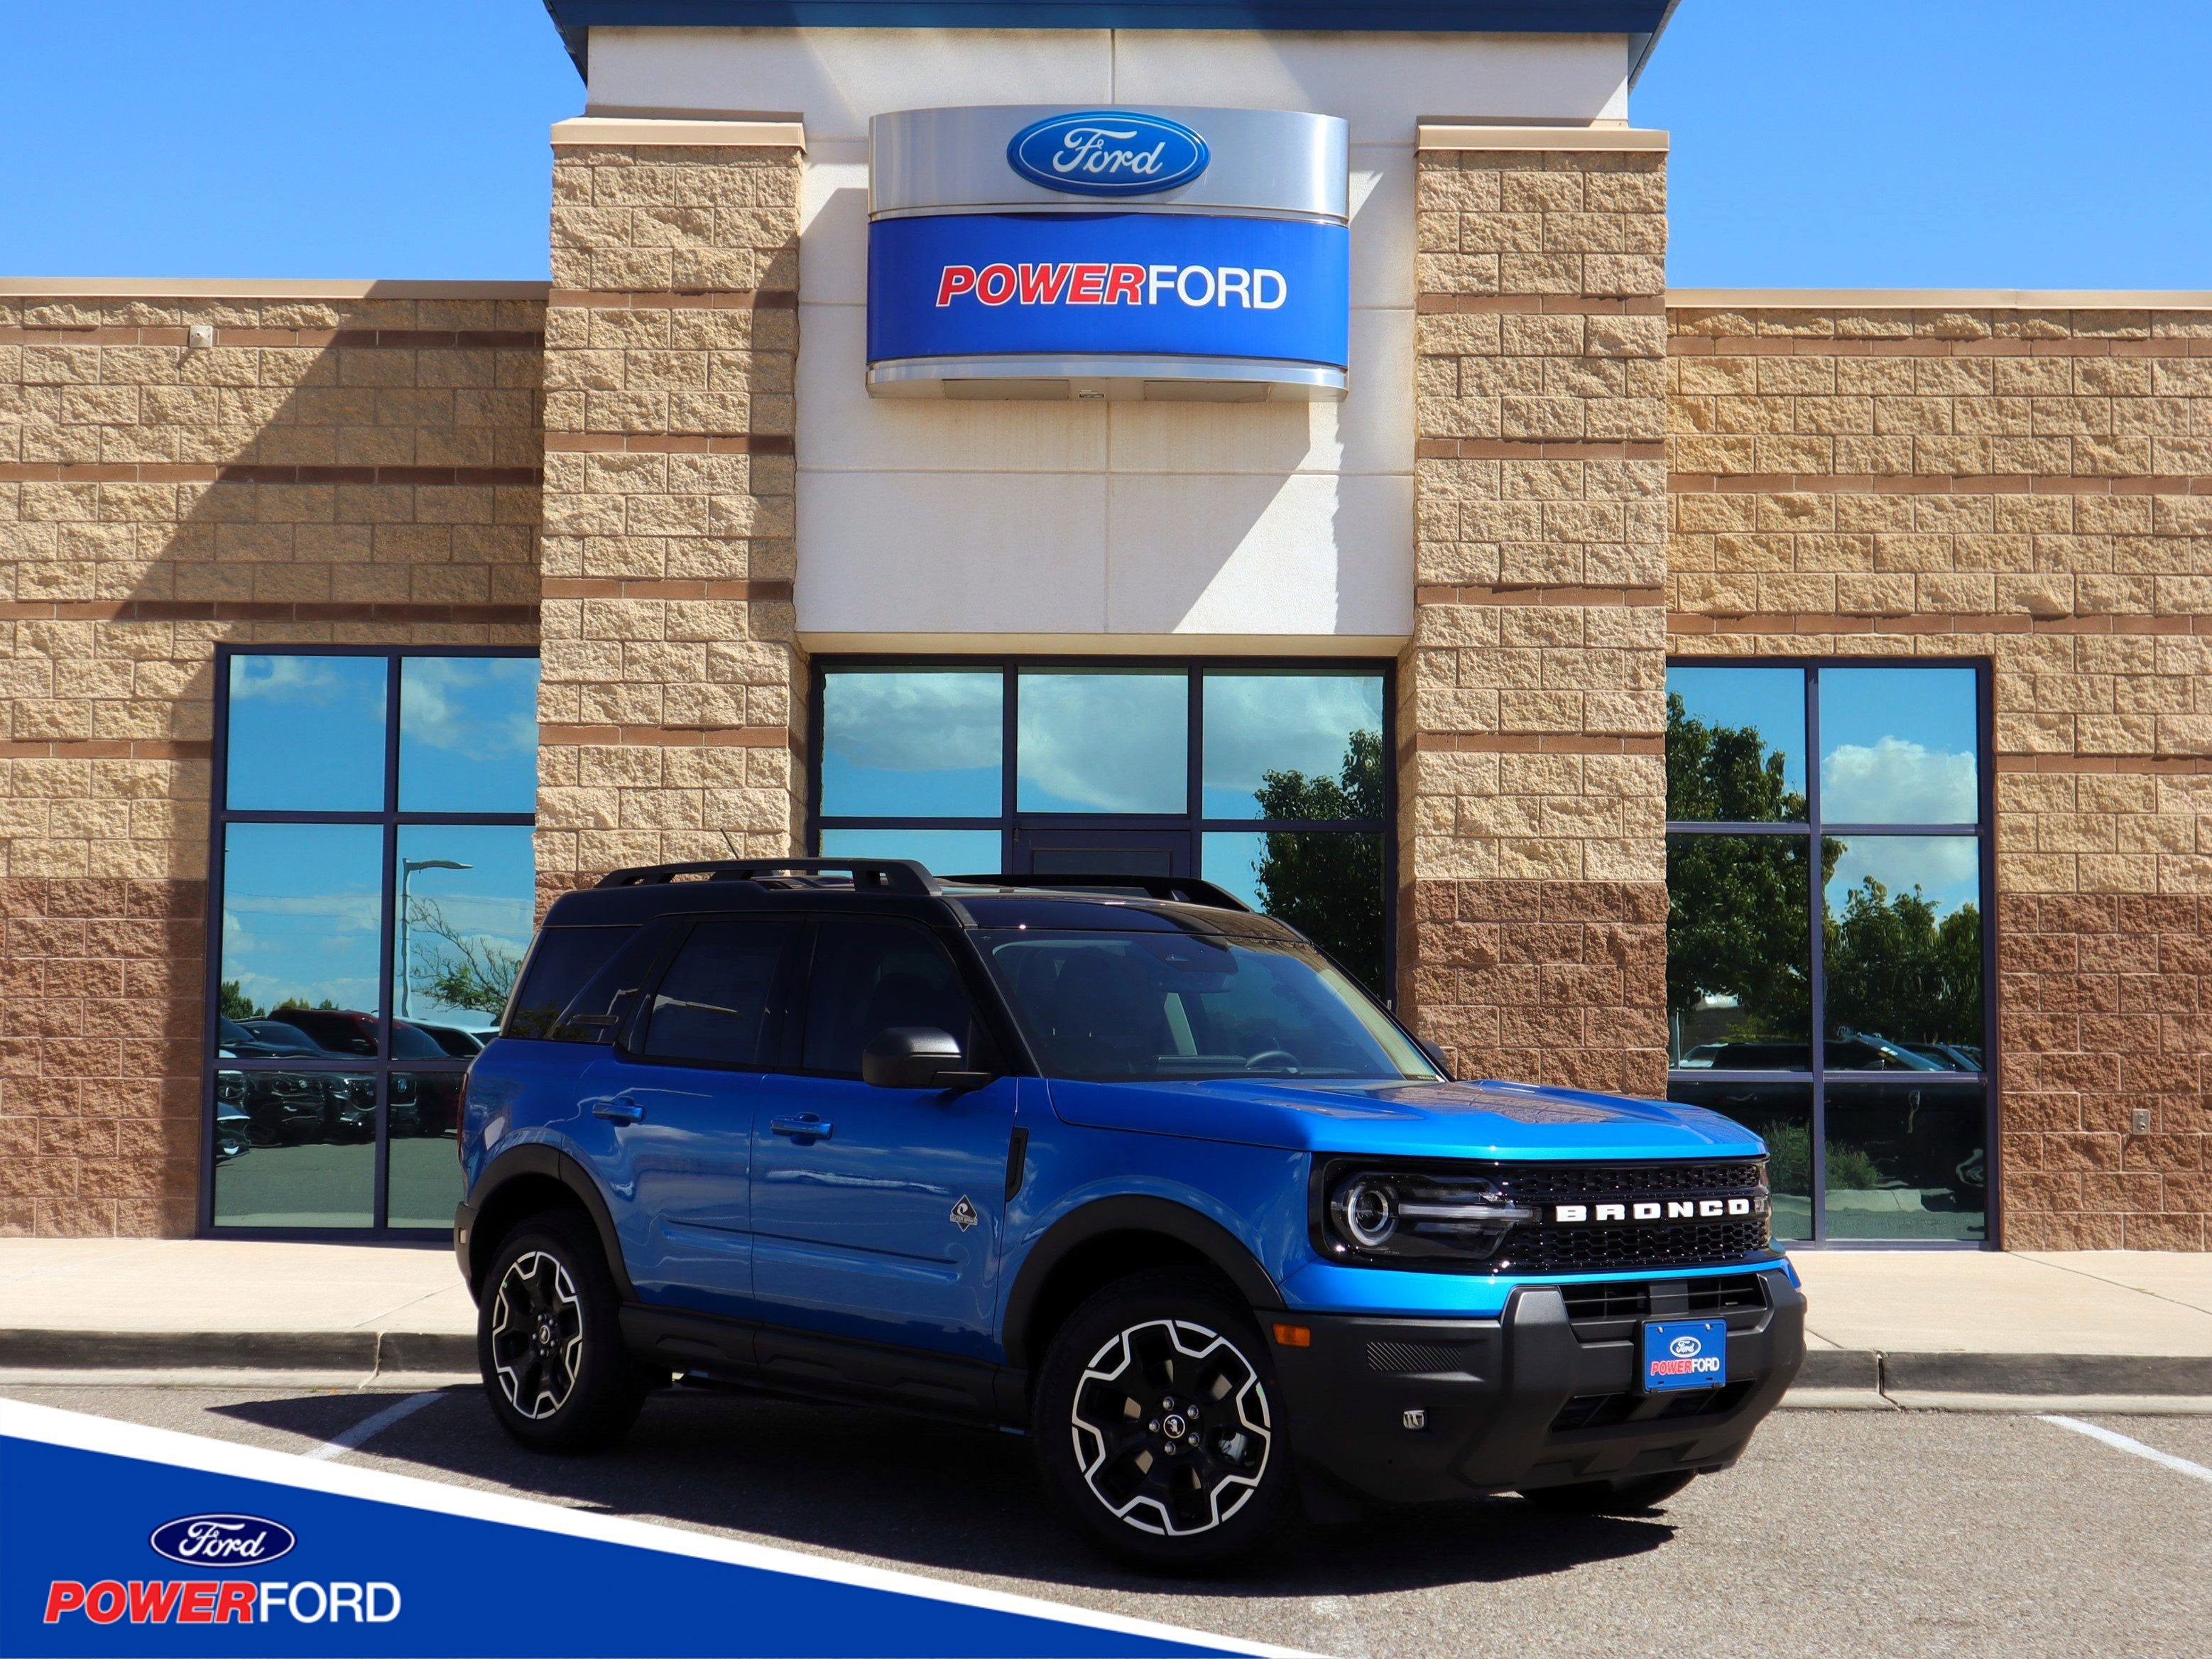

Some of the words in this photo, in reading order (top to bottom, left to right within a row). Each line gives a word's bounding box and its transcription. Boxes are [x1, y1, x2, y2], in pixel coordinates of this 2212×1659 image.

[1052, 127, 1164, 174] Ford
[1555, 1198, 1750, 1222] BRONCO
[1675, 1339, 1695, 1354] Ford
